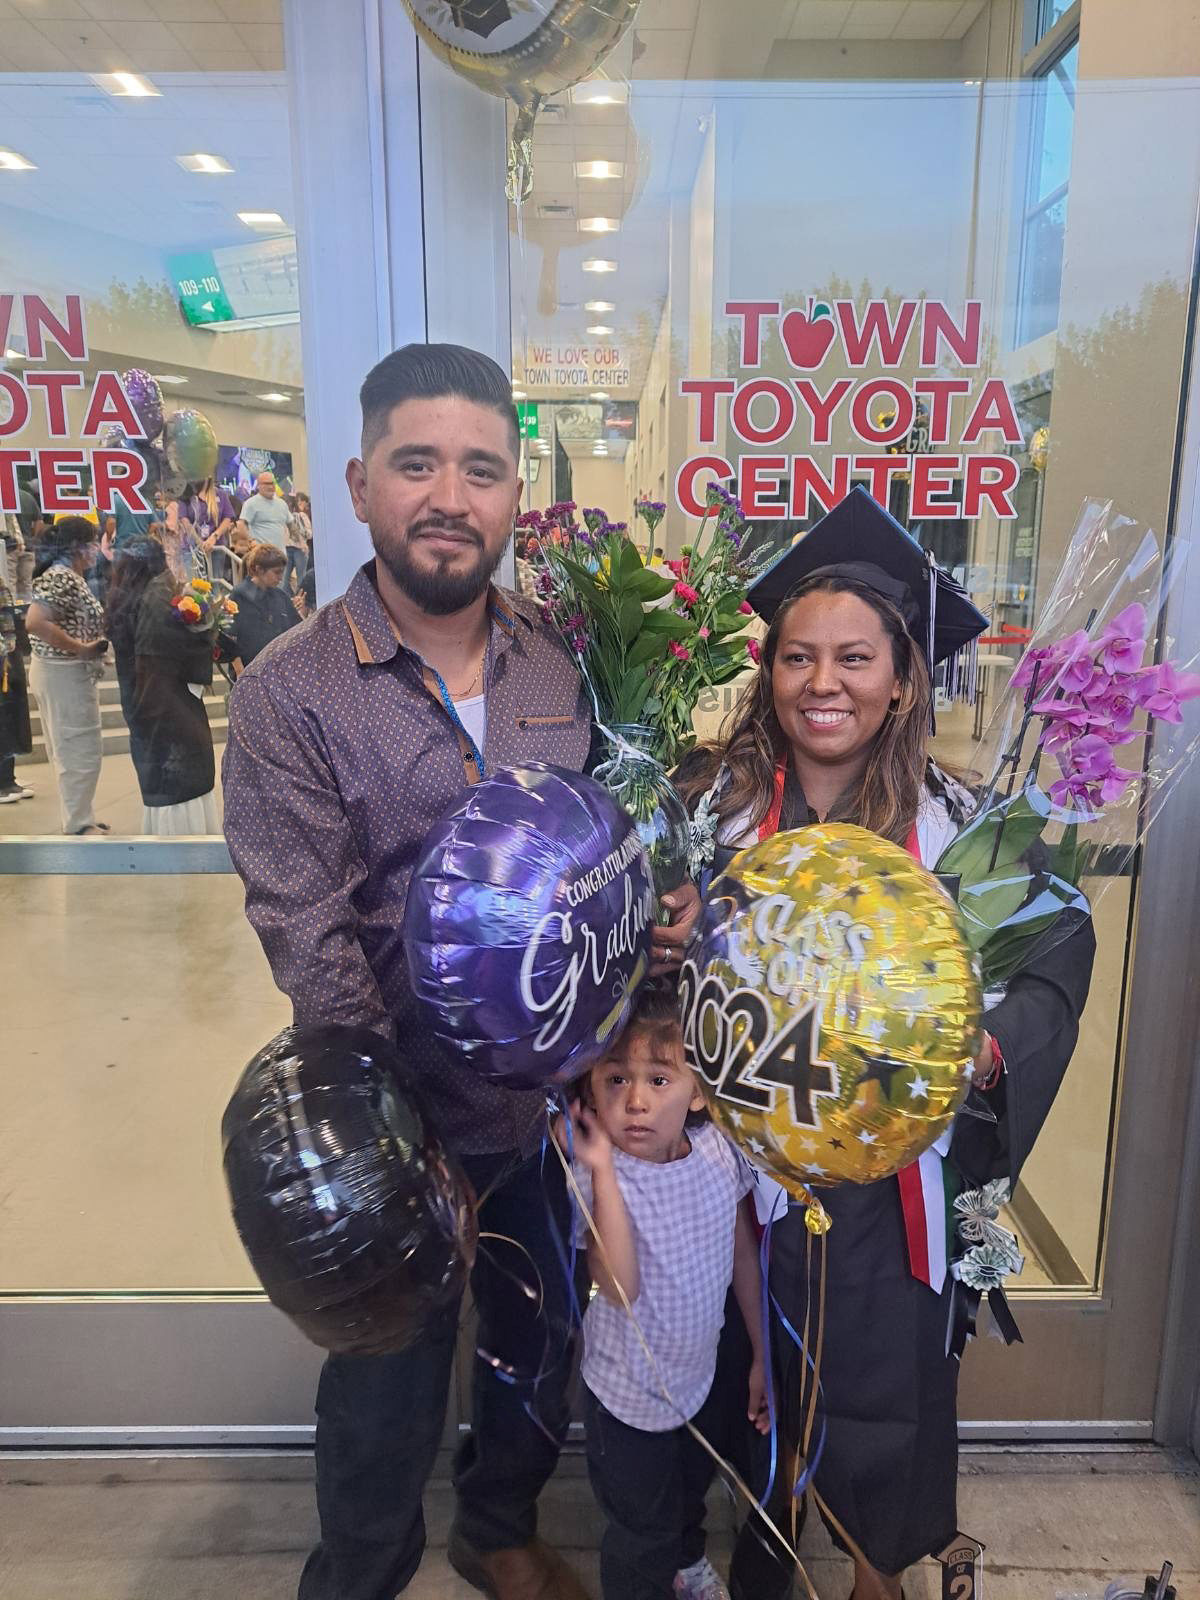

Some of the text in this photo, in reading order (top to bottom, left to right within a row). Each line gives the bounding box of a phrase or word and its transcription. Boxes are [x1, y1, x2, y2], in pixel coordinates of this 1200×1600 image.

[178, 276, 220, 296] 109-110
[533, 347, 620, 364] WE LOVE OUR
[524, 368, 629, 385] TOWN TOYOTA CENTER
[679, 377, 1025, 445] TOYOTA
[906, 427, 935, 453] GR
[675, 454, 1020, 520] CENTER
[678, 960, 840, 1131] 2024
